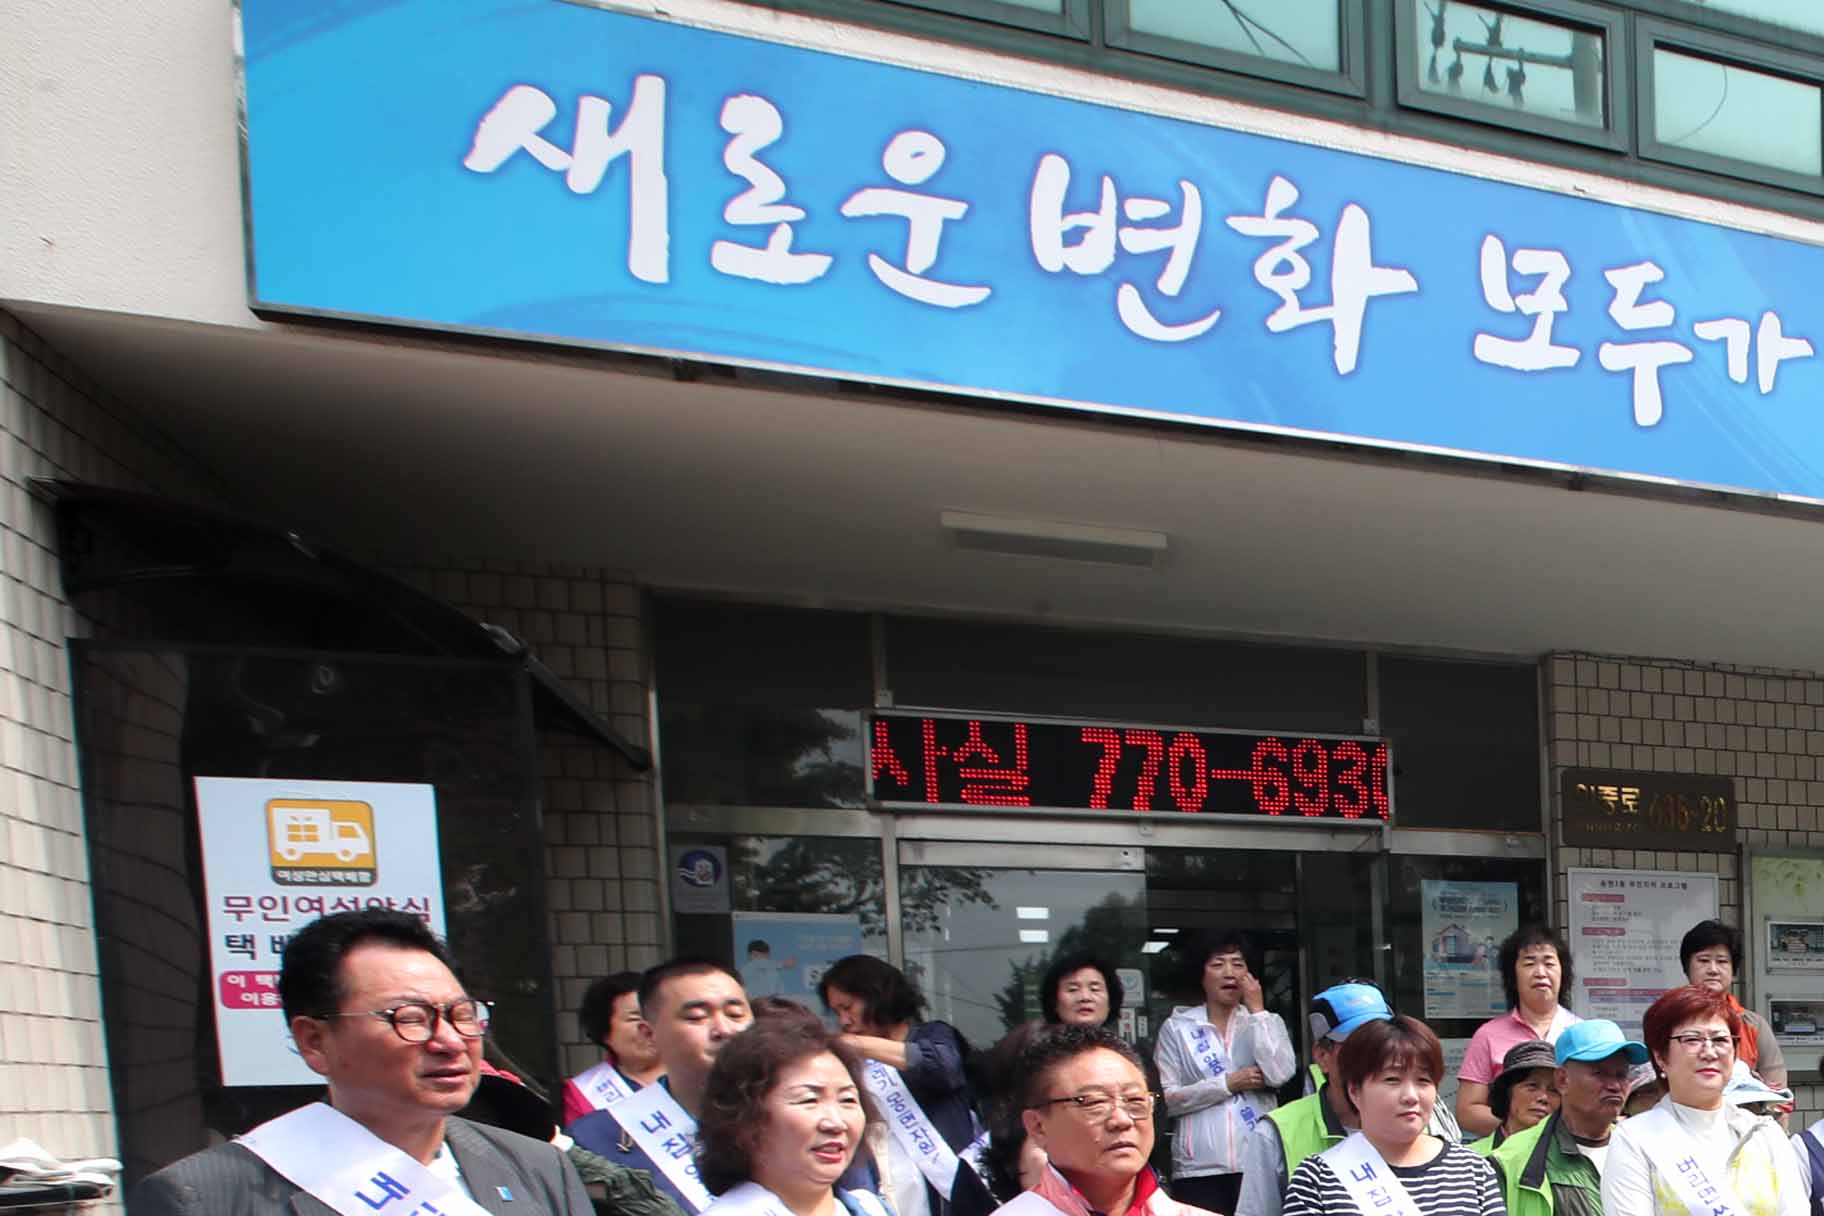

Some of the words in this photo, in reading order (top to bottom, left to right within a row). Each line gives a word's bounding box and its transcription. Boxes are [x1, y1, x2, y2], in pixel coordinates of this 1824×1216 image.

[464, 76, 991, 309] 새로운
[1030, 154, 1418, 375] 변화
[1474, 234, 1814, 426] 모두가
[640, 1110, 672, 1134] 내
[661, 1132, 695, 1160] 집
[352, 1169, 412, 1211] 내
[1349, 1161, 1379, 1184] 내
[1368, 1185, 1392, 1208] 집
[1675, 1155, 1721, 1206] 버리면
